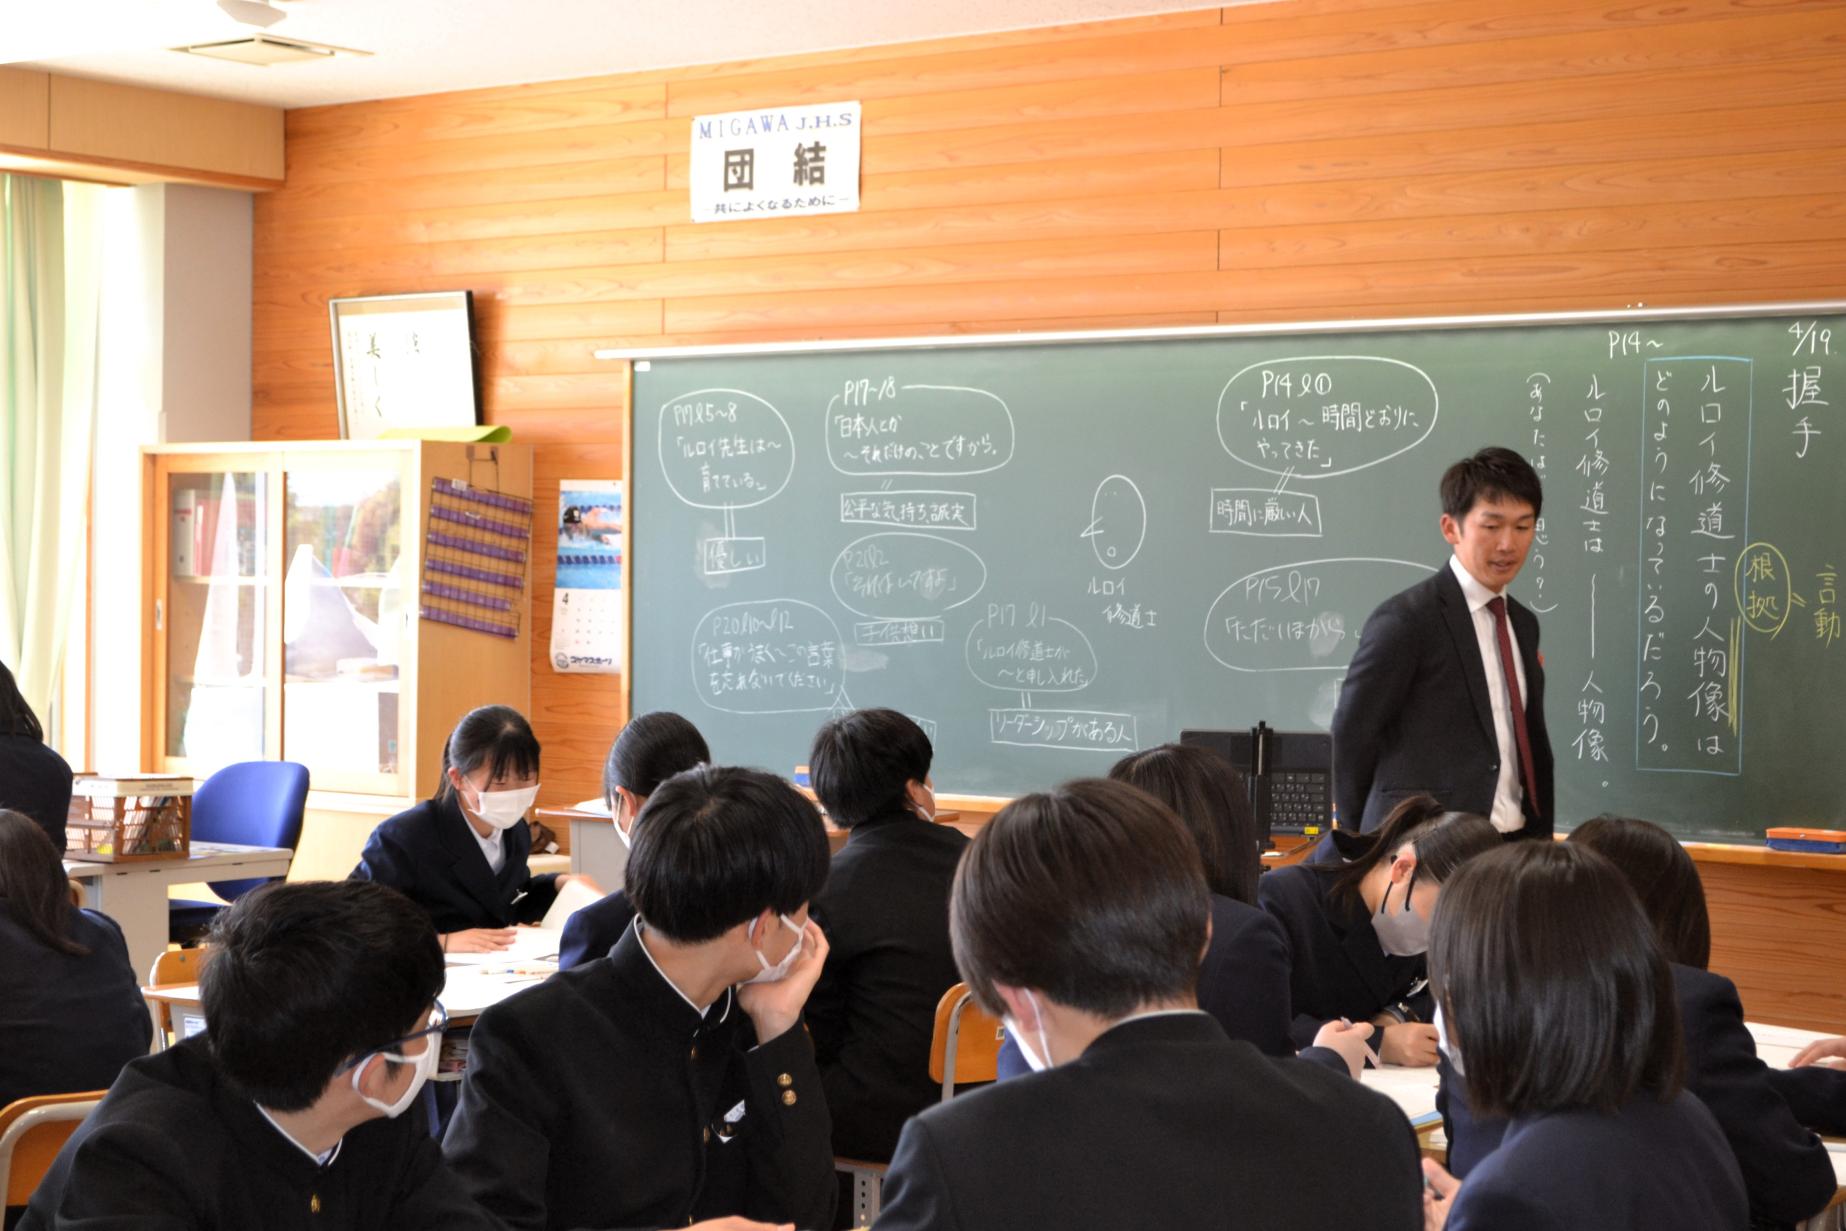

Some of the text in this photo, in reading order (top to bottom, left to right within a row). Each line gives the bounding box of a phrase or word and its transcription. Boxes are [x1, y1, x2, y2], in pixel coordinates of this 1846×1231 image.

[699, 114, 789, 139] MIGAWA
[1787, 321, 1832, 356] 4/19
[1781, 365, 1830, 458] 握手
[1216, 496, 1312, 527] 時間に厳しい人
[709, 541, 760, 570] 優しい
[1687, 365, 1735, 755] ルロイ修道士の人物像は
[562, 592, 569, 605] 4
[1088, 576, 1126, 597] ルロイ
[1746, 553, 1779, 622] 根拠
[1101, 603, 1157, 629] 修道士
[1813, 563, 1841, 649] 言動
